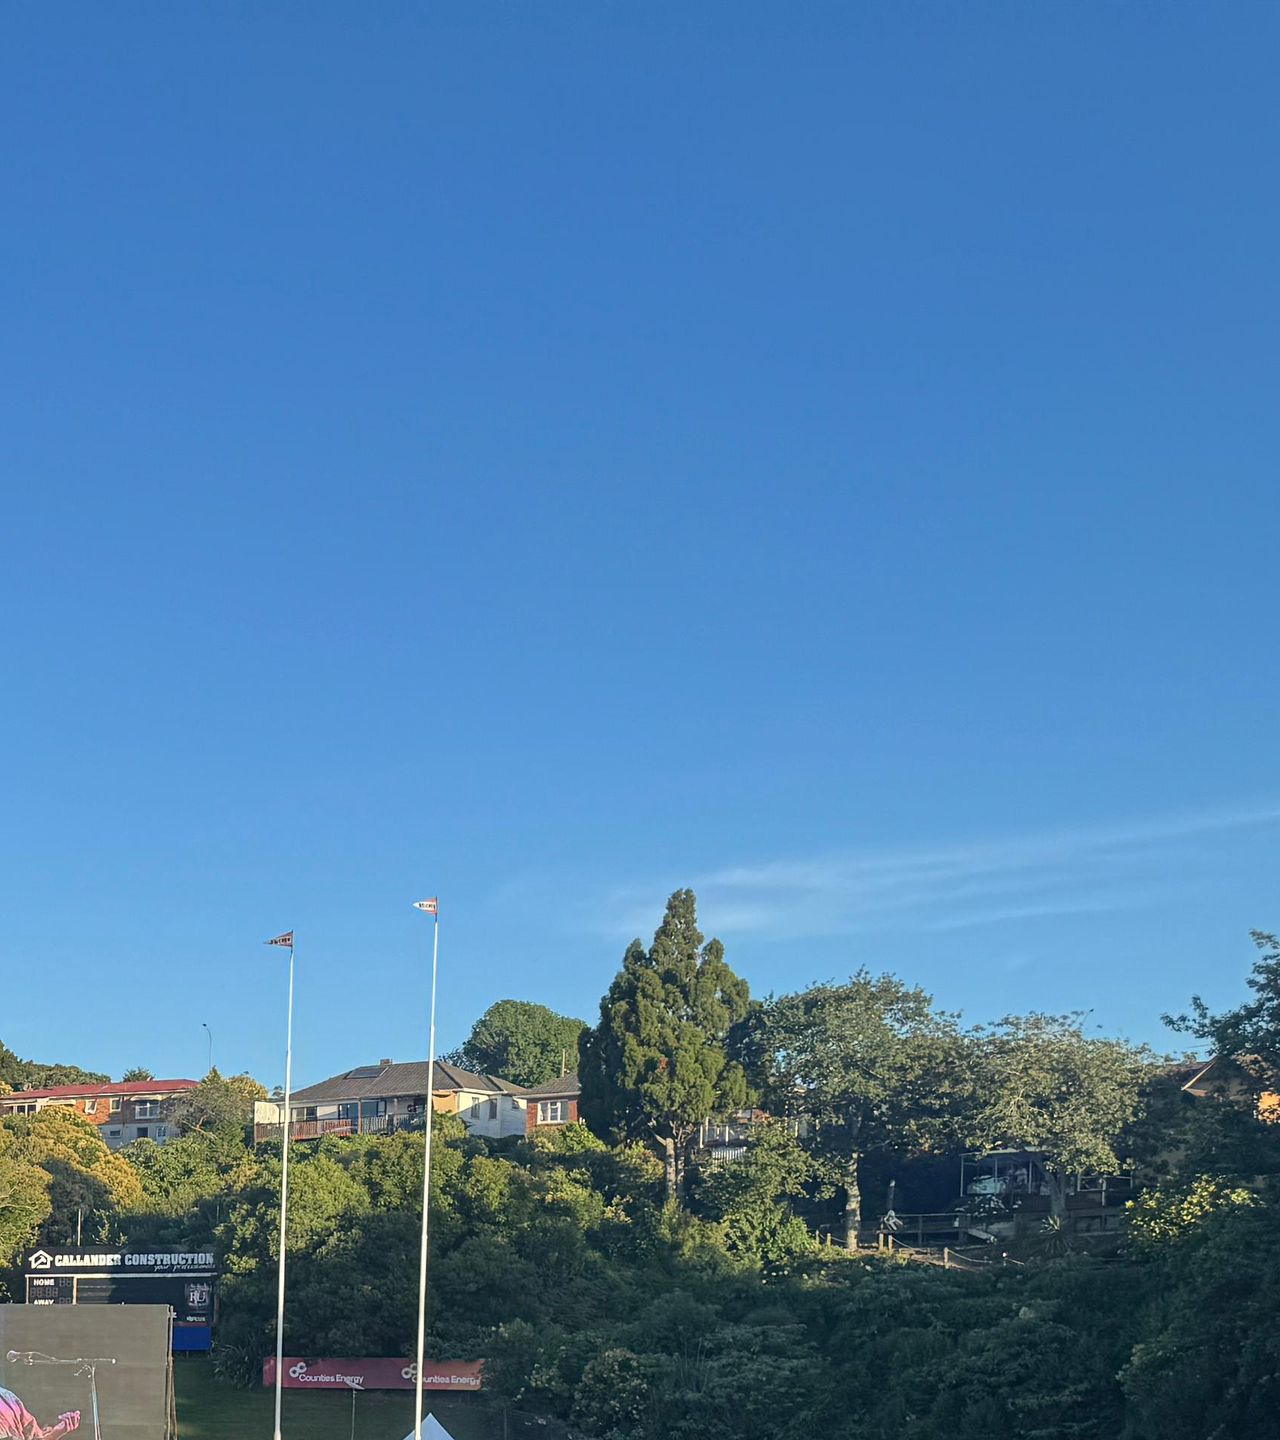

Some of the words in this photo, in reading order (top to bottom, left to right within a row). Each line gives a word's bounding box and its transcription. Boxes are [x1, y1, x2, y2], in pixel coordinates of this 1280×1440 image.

[55, 1254, 121, 1267] CALLANDER
[124, 1253, 214, 1266] CONSTRUCTION
[33, 1278, 55, 1286] HOME
[299, 1373, 335, 1383] Counties
[336, 1374, 364, 1384] Energy
[412, 1374, 449, 1384] Cunties
